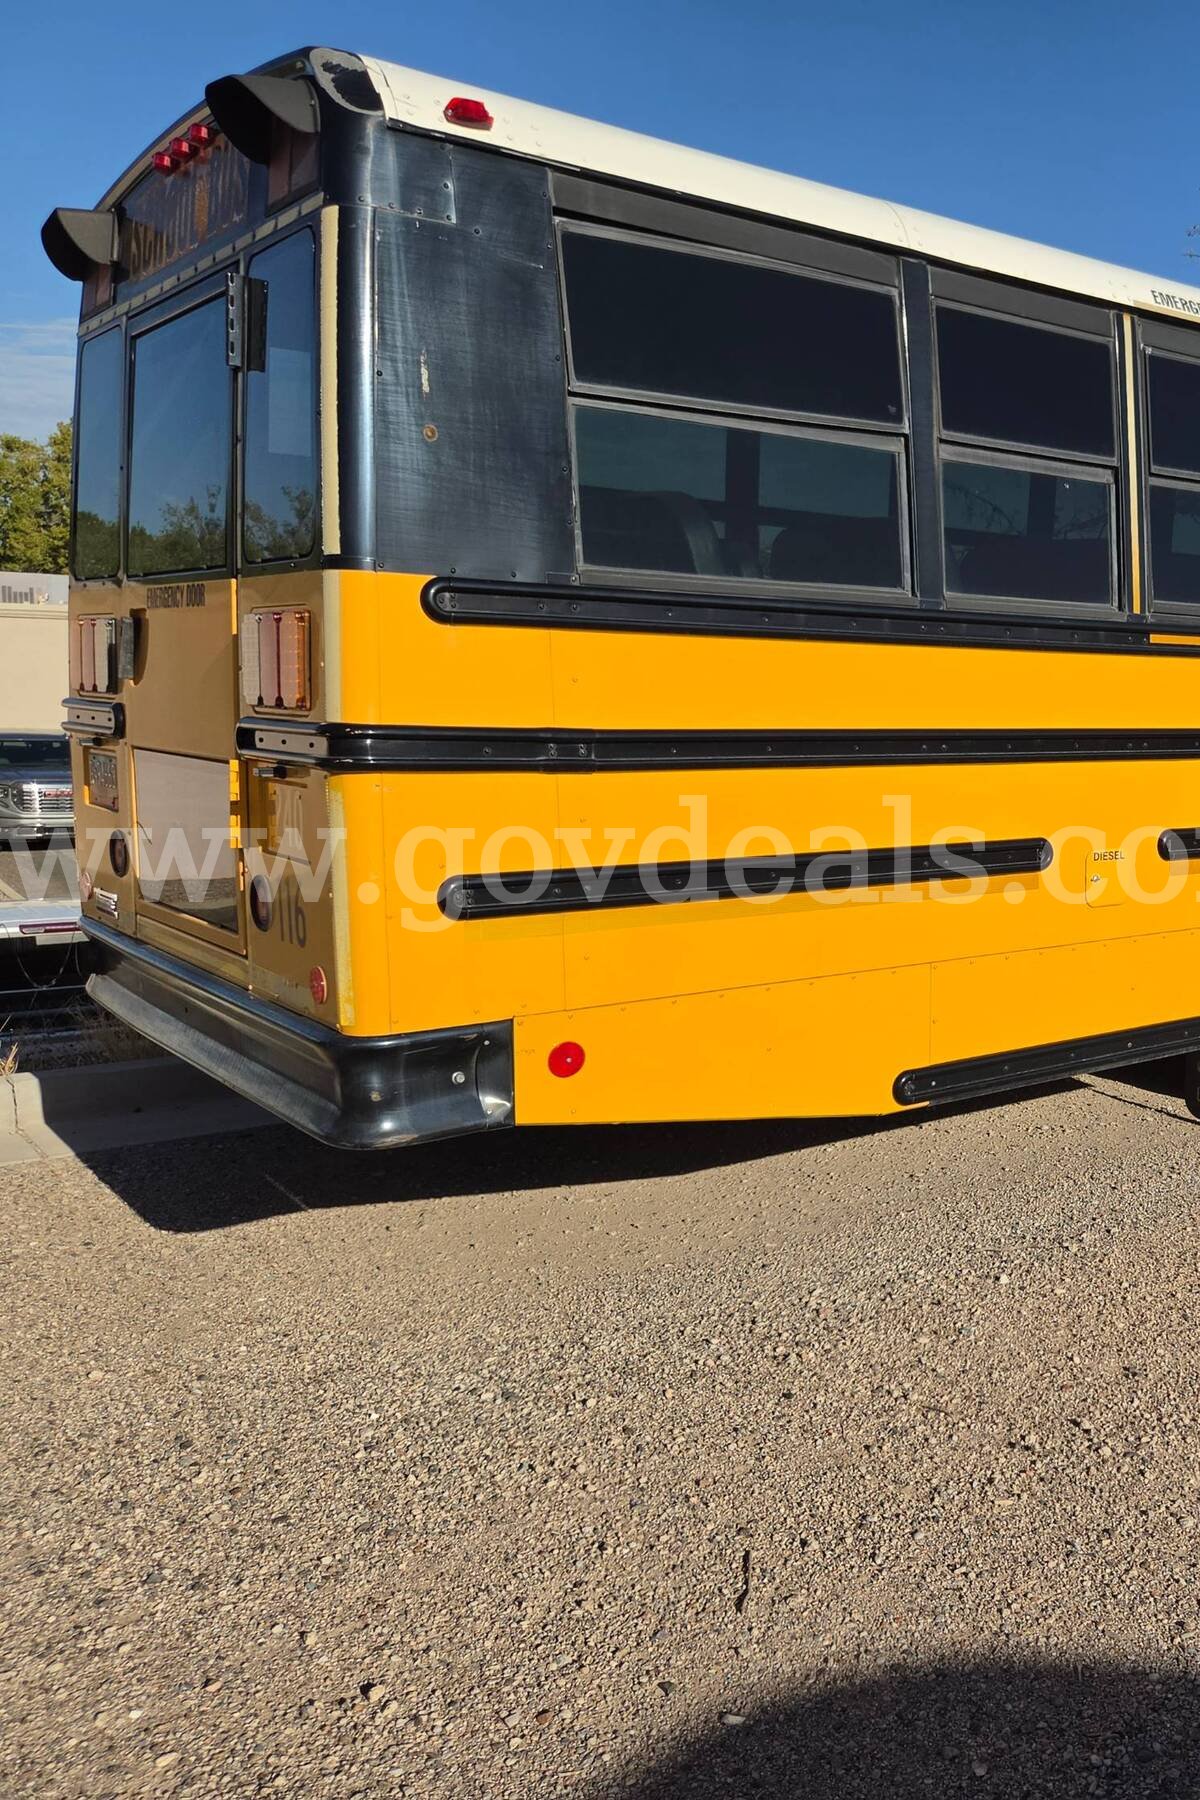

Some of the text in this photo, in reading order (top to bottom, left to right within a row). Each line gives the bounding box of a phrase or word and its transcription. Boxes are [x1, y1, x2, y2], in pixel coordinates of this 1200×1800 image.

[147, 583, 206, 608] EMERGENCY DOOR
[1094, 851, 1125, 861] DIESEL
[278, 877, 306, 948] 116
